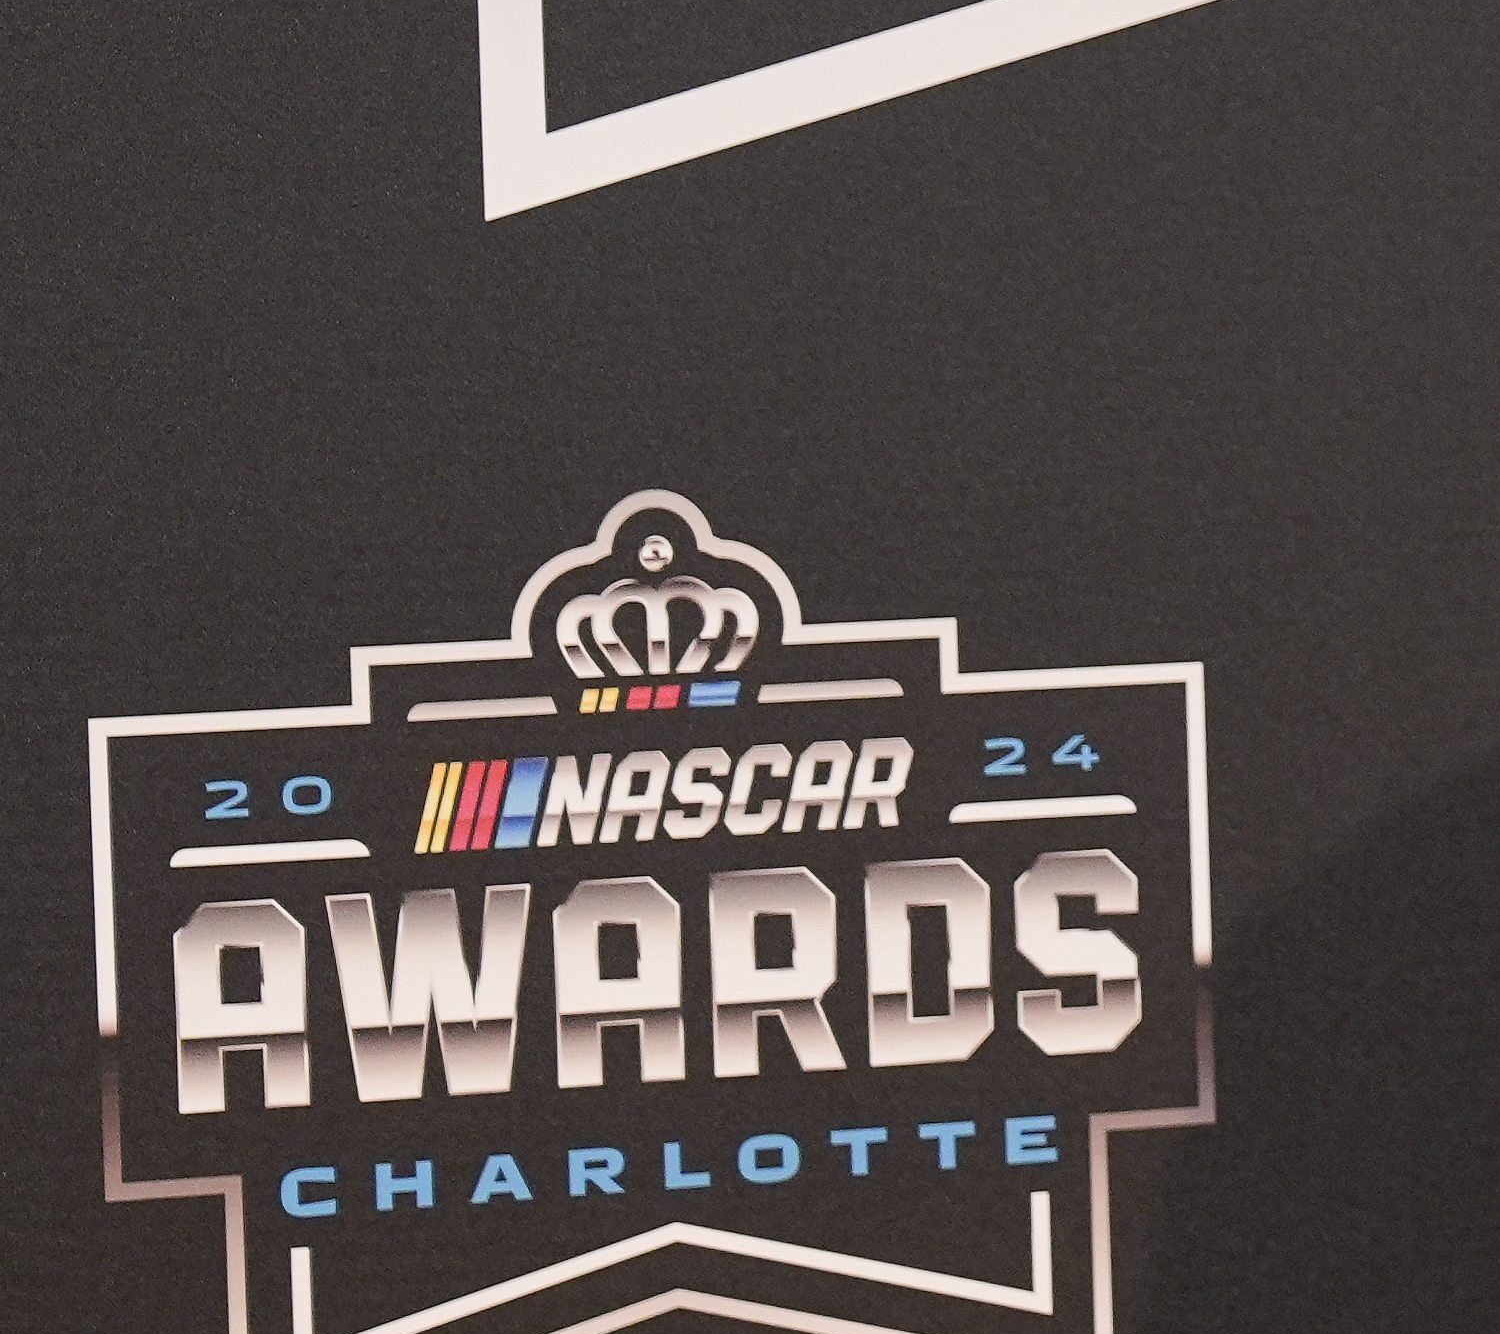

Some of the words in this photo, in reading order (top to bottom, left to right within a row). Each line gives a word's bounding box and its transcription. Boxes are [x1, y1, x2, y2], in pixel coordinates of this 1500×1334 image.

[204, 774, 335, 820] 20
[535, 735, 914, 846] NASCAR
[984, 733, 1101, 777] 24
[172, 847, 1144, 1115] AWARDS
[278, 1114, 1060, 1219] CHARLOTTE
